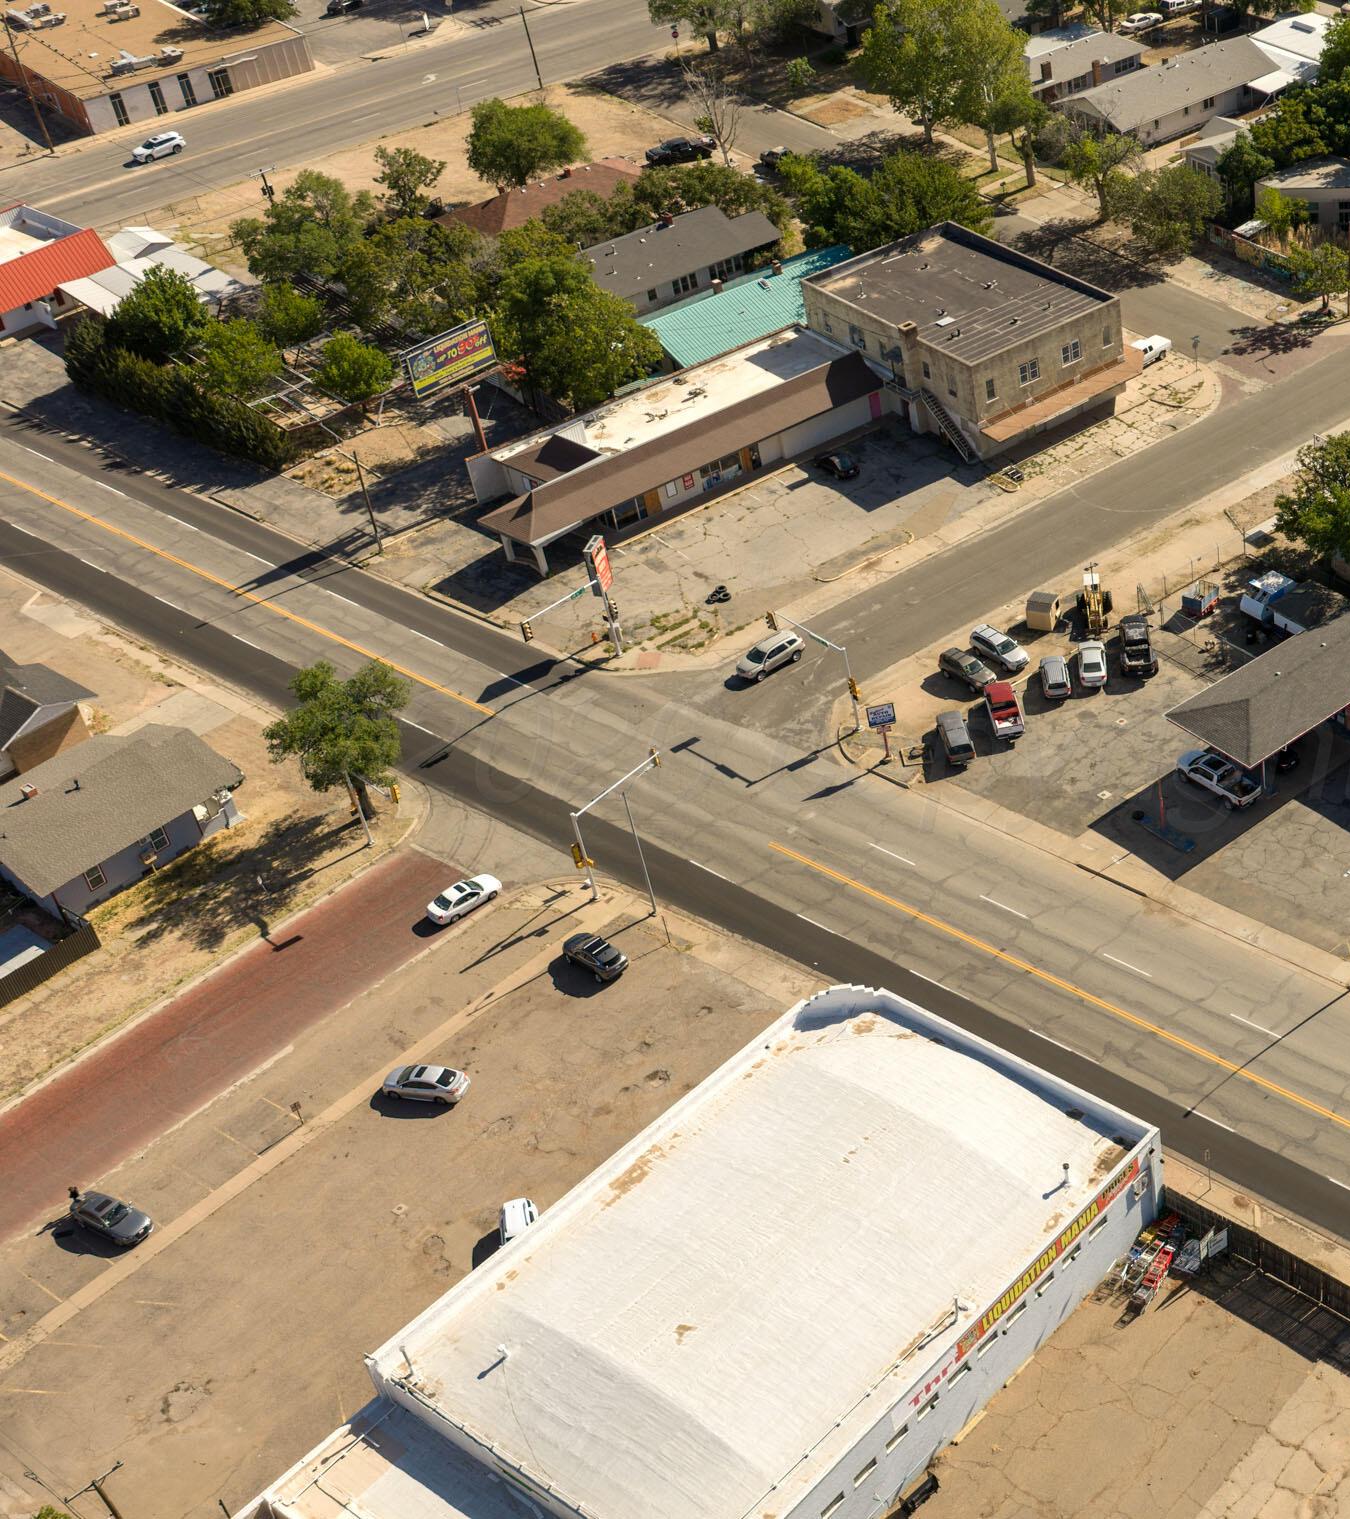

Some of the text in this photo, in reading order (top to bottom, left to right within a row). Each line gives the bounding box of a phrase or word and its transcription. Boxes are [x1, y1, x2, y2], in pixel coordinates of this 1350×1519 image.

[447, 348, 458, 359] TO
[981, 1202, 1099, 1331] LIQUIDATION MANIA
